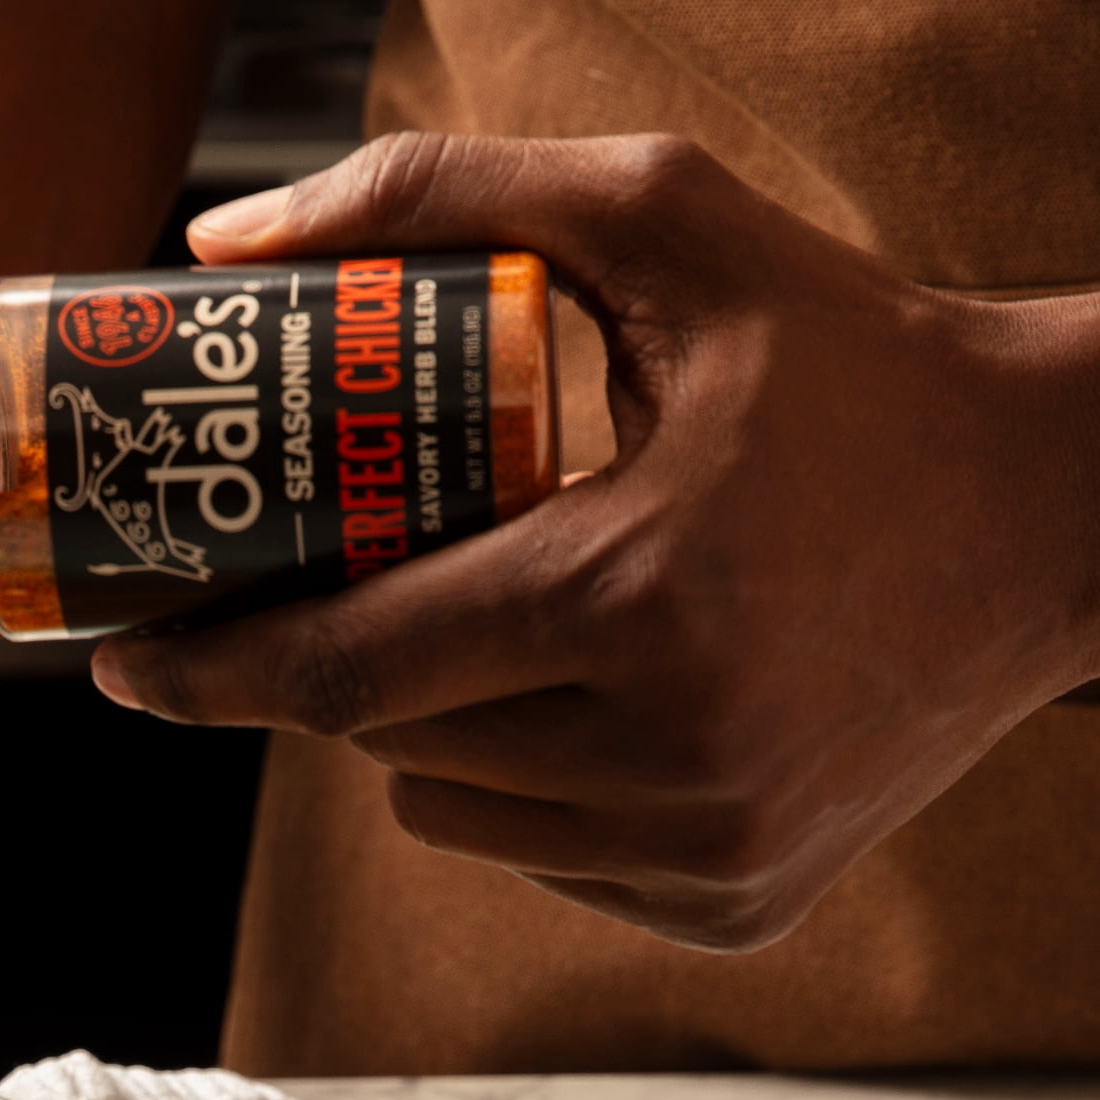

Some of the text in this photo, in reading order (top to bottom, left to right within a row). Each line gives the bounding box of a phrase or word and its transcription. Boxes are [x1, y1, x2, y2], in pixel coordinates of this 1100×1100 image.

[72, 307, 95, 349] SINCE
[463, 369, 482, 394] OZ
[142, 294, 261, 531] dale's
[280, 312, 314, 500] SEASONING
[414, 279, 442, 533] SAVORY HERB BLEND
[465, 428, 482, 454] WT
[466, 459, 483, 491] NET
